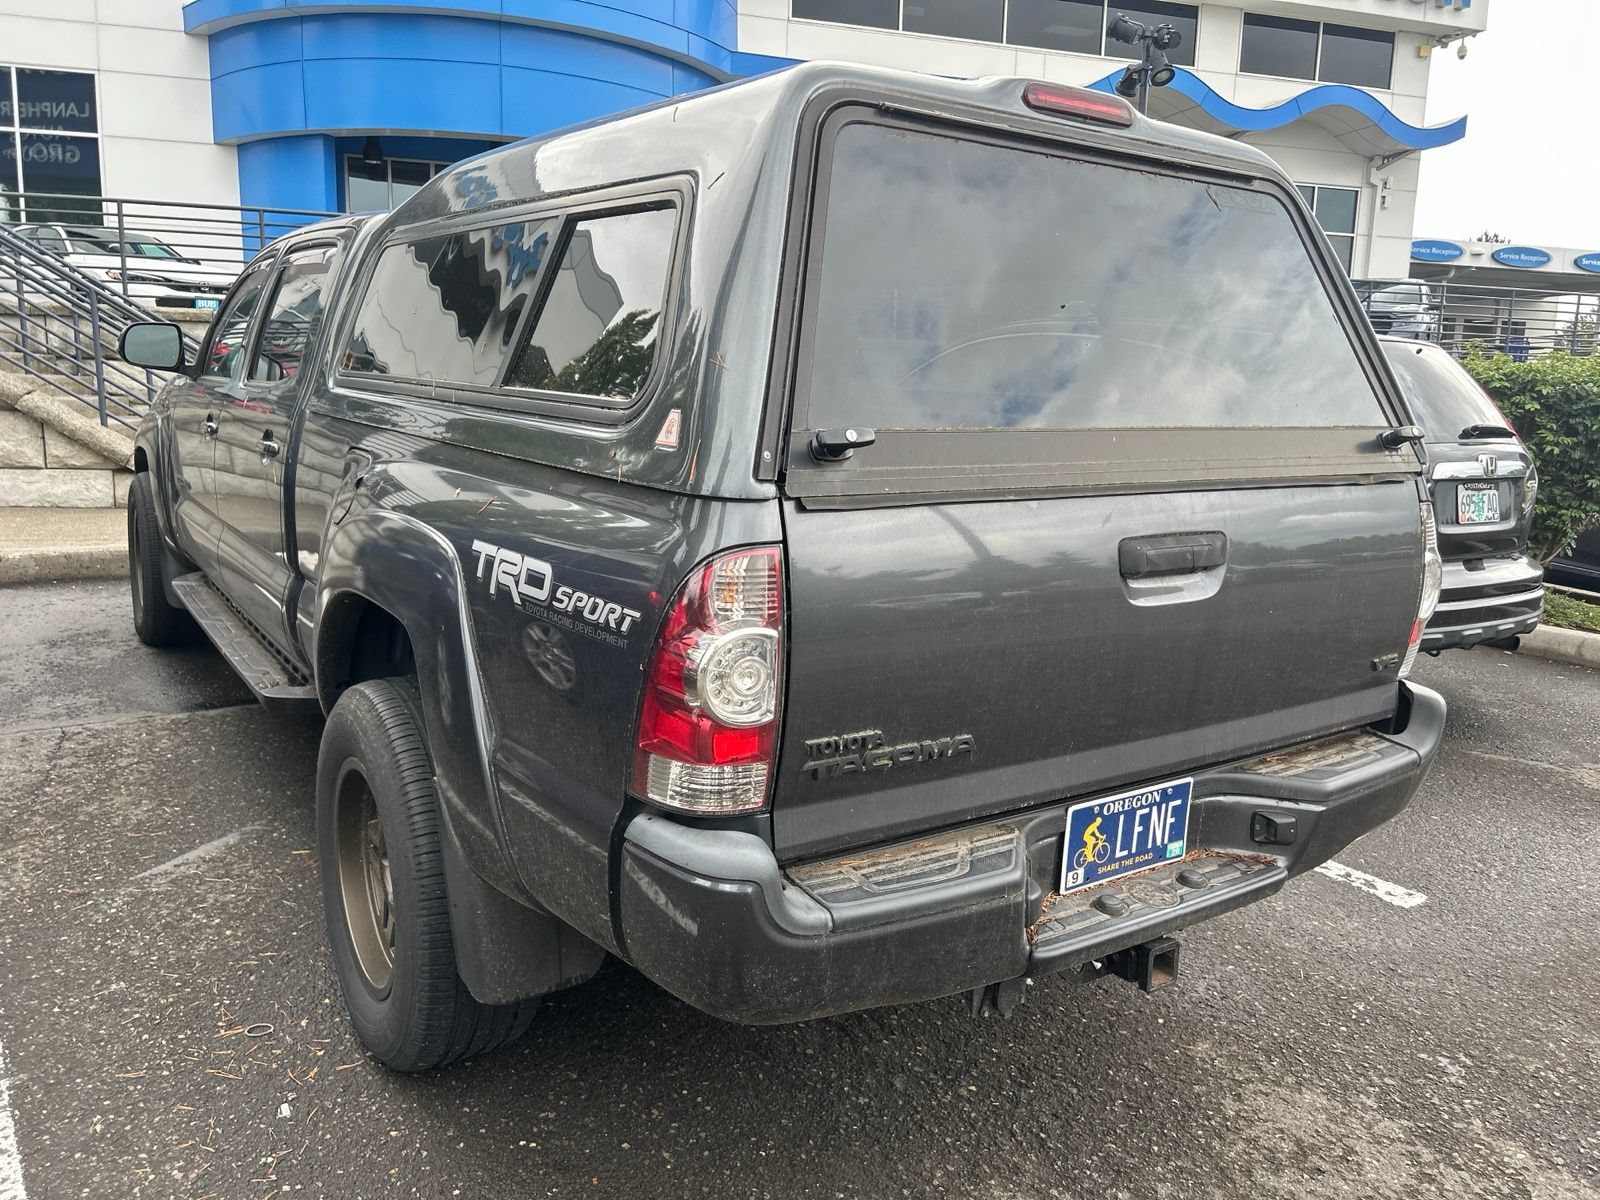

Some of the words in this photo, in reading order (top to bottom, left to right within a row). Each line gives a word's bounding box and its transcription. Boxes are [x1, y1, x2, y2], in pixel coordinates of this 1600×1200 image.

[1431, 247, 1460, 256] Reception
[1499, 251, 1520, 260] Service
[1520, 253, 1548, 262] Reception
[471, 538, 553, 607] TRD
[552, 586, 643, 635] SPORT
[525, 601, 548, 618] TOYOTA
[549, 611, 573, 630] RACING
[574, 620, 629, 650] DEVELOPMENT
[804, 729, 885, 757] TOYOTA
[801, 734, 977, 781] TACOMA
[1103, 790, 1162, 816] OREGON
[1115, 799, 1182, 858] LFNF
[1097, 863, 1120, 875] SHARE
[1121, 857, 1134, 869] THE
[1135, 852, 1153, 864] ROAD
[1071, 872, 1079, 884] 9
